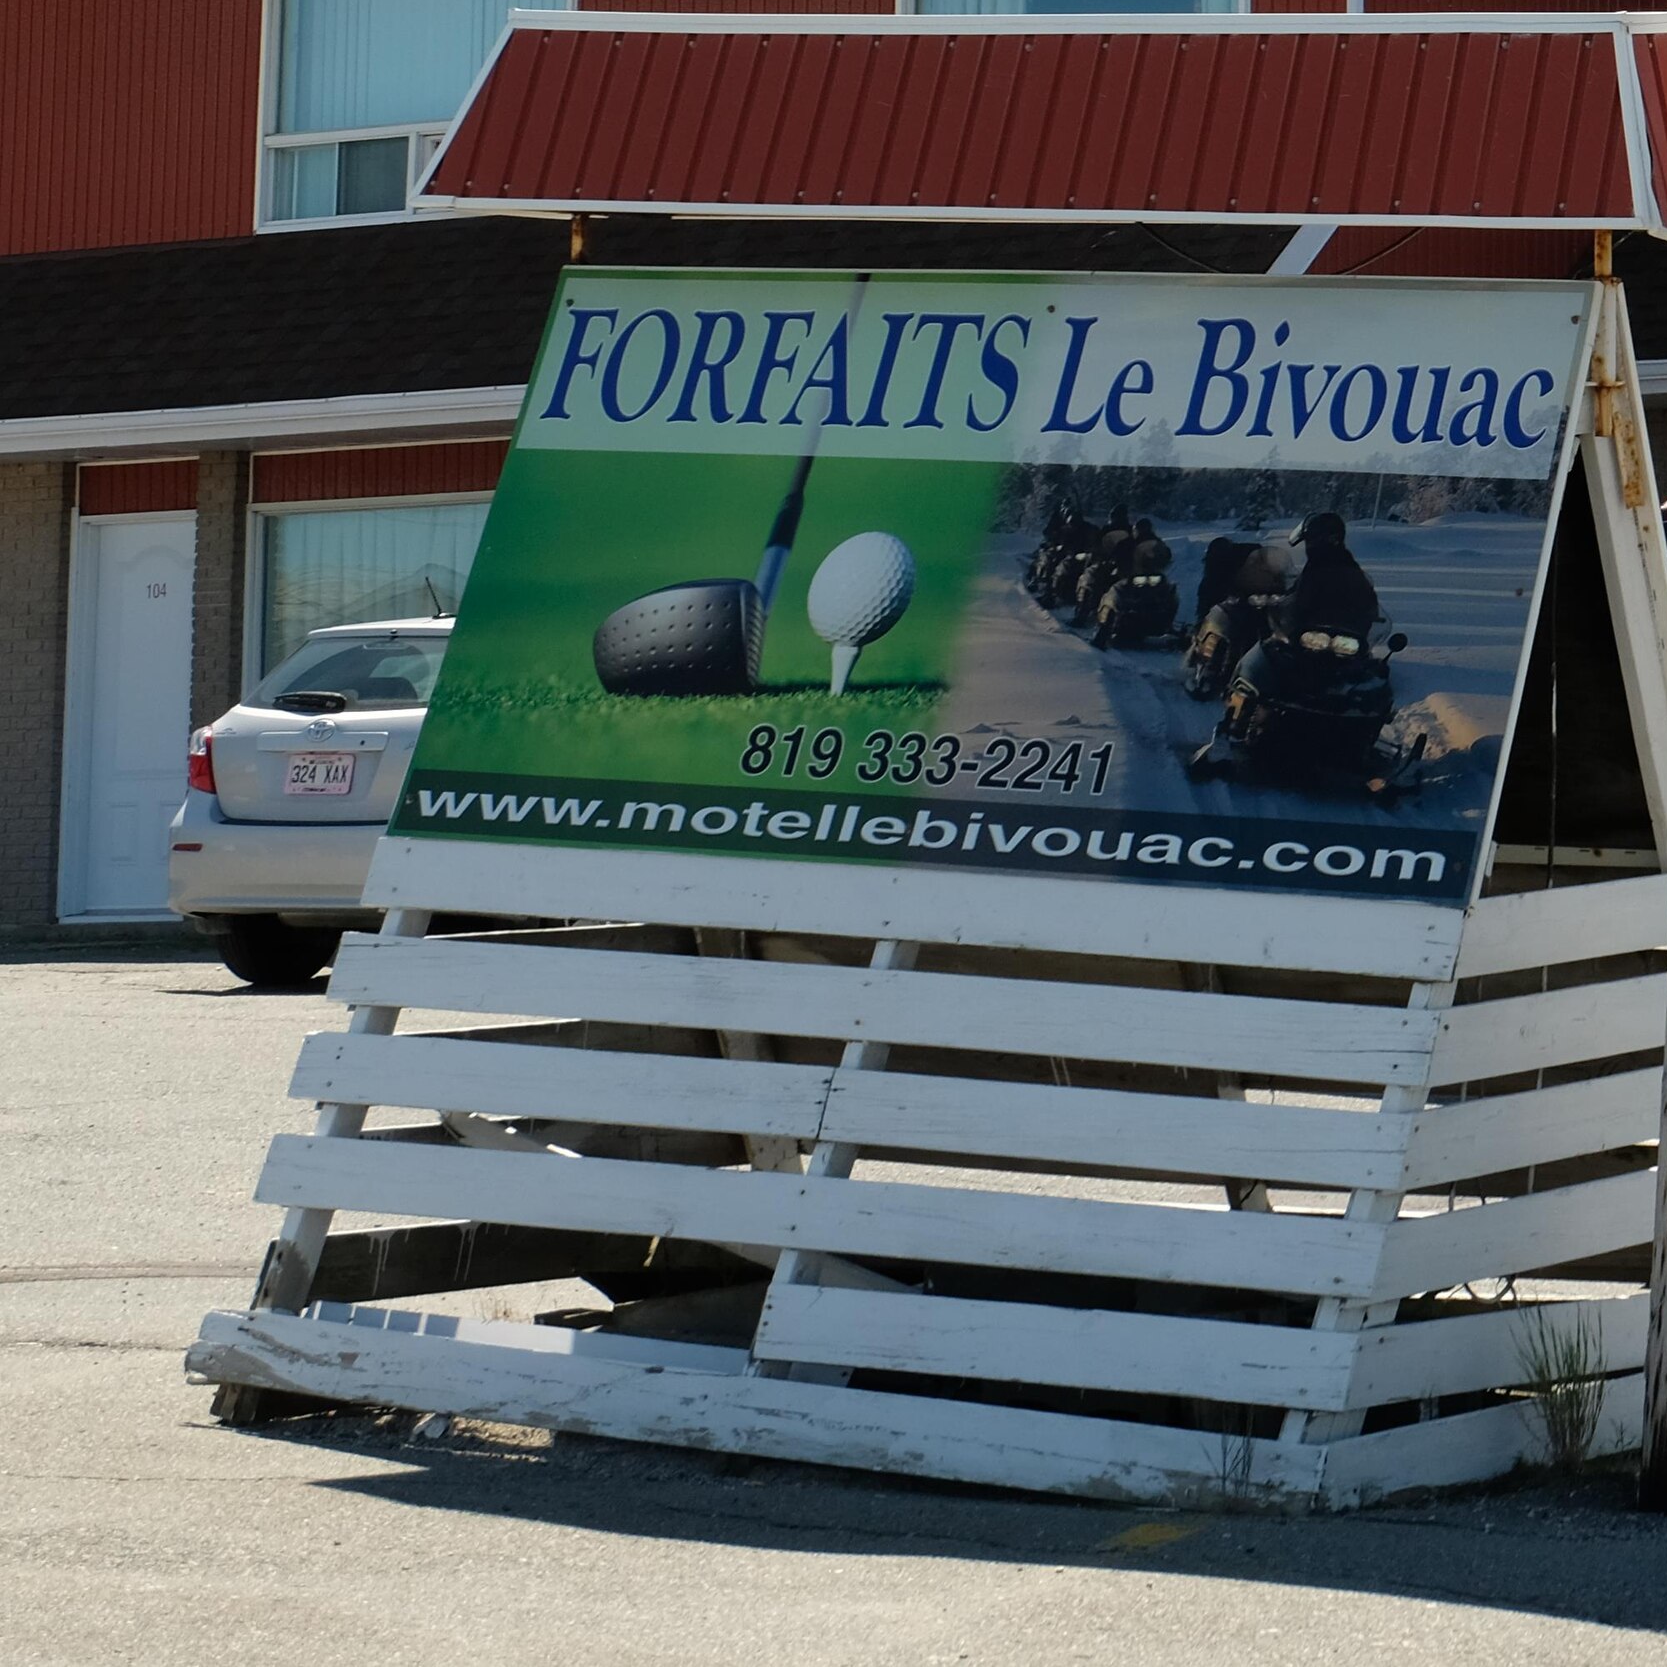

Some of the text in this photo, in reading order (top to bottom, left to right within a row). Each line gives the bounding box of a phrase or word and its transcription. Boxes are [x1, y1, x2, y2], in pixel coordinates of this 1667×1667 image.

[539, 307, 1556, 449] FORFAITS Le Bivouac
[147, 583, 166, 599] 104
[291, 765, 348, 783] 324 XAX
[739, 723, 1115, 796] 819 333-2241
[418, 788, 1447, 883] www.motellebivouac.com
